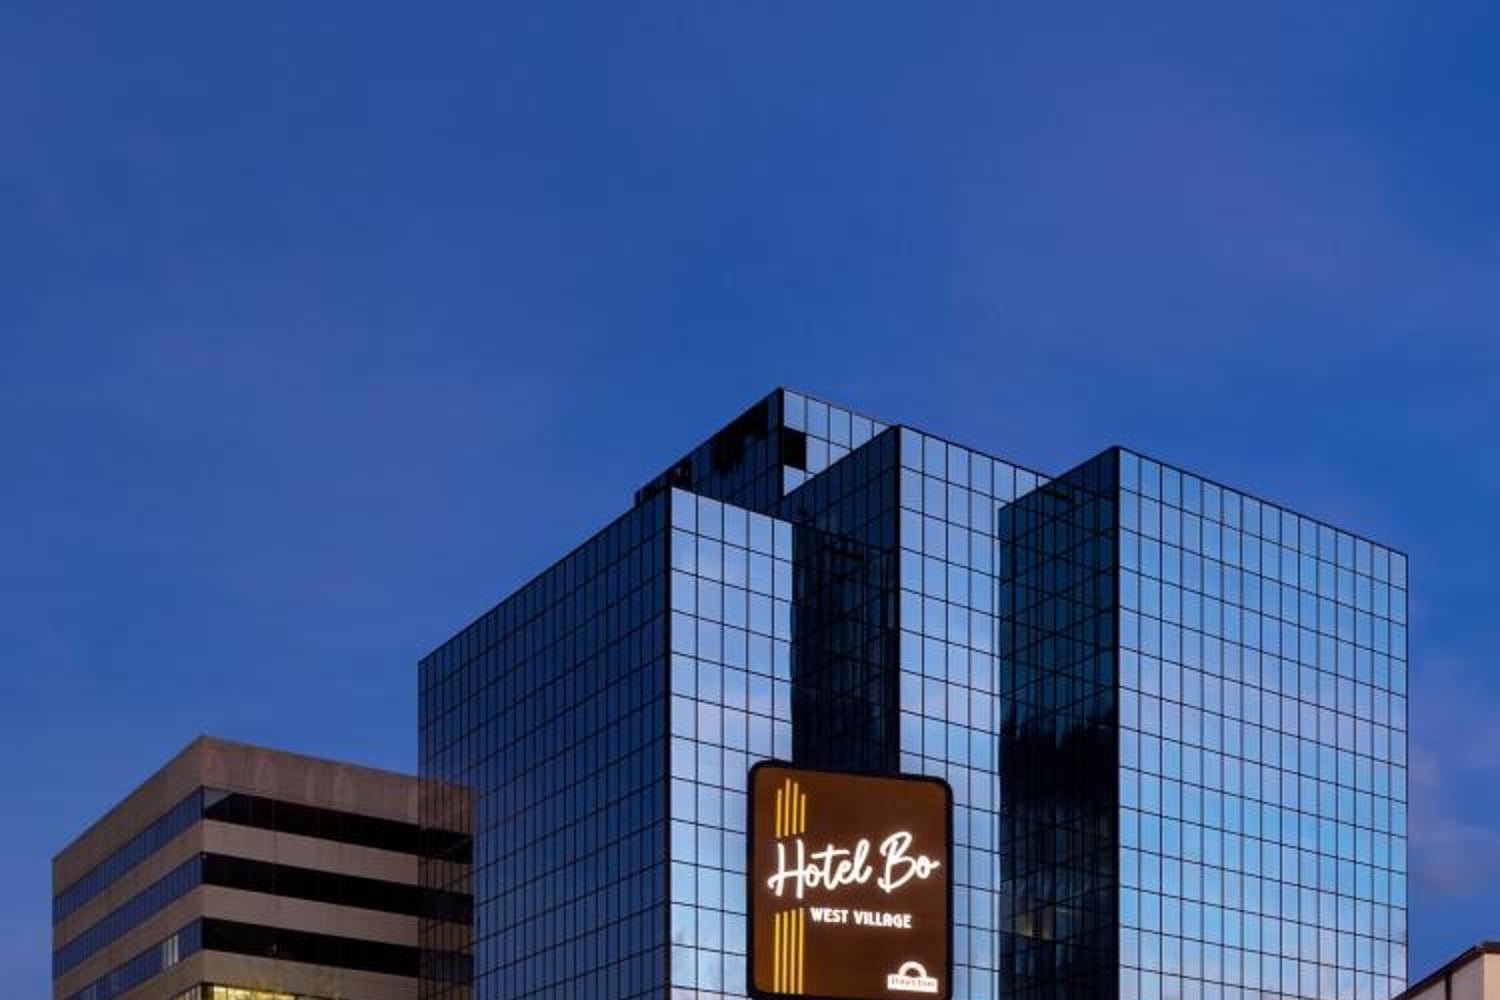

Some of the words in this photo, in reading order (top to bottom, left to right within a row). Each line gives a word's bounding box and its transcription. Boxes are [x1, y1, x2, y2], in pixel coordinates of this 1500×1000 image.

[767, 839, 872, 899] Hotel
[877, 831, 940, 892] Bo
[810, 907, 849, 923] WEST
[853, 910, 912, 929] VILLAGE
